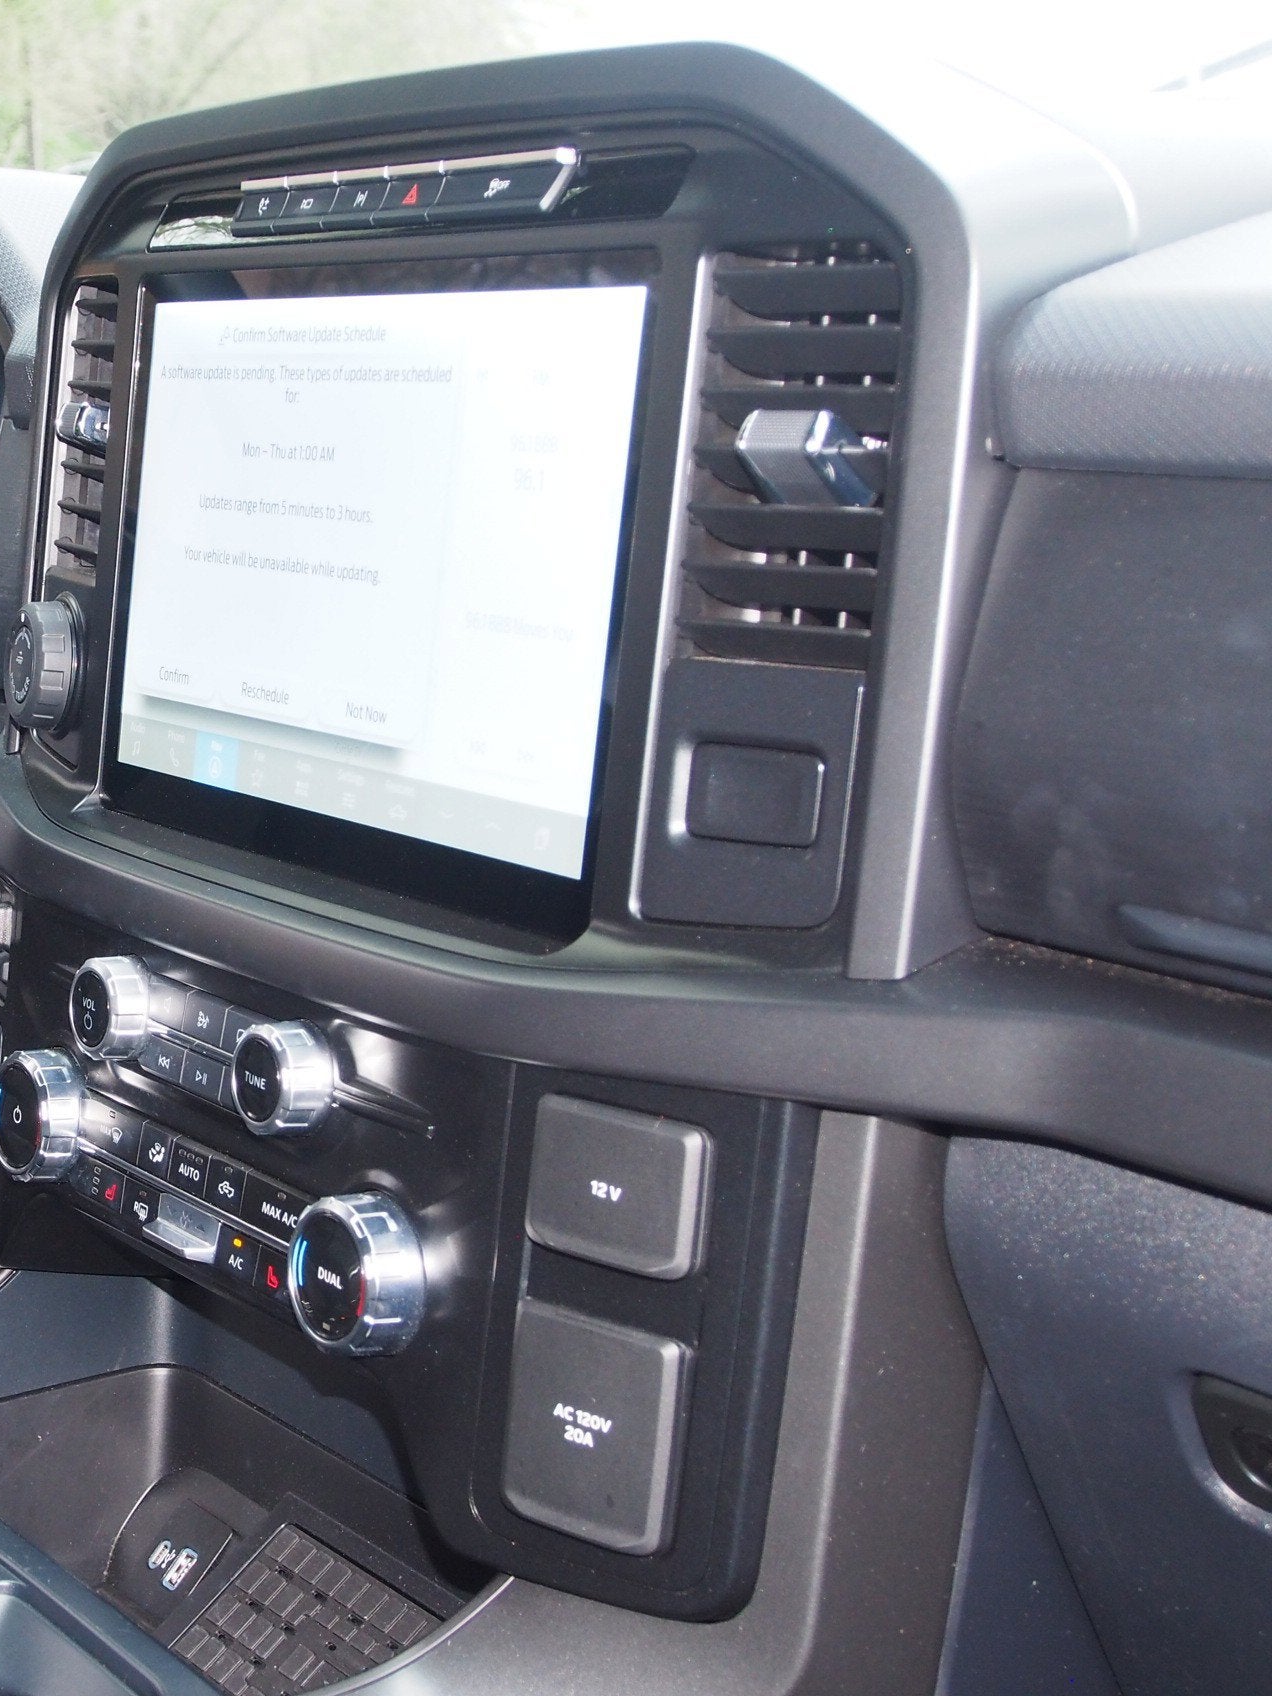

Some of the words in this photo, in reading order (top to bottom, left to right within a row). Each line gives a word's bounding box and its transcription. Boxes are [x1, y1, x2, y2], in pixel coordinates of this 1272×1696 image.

[233, 326, 265, 344] Confirm
[268, 326, 306, 342] Software
[309, 327, 341, 343] Update
[343, 325, 386, 342] Schedule
[161, 367, 167, 379] A
[168, 365, 202, 380] software
[203, 366, 232, 381] update
[233, 366, 240, 380] is
[241, 365, 277, 382] pending.
[280, 365, 304, 380] These
[307, 366, 331, 383] types
[333, 365, 343, 381] of
[344, 365, 382, 383] updates
[384, 368, 399, 382] are
[401, 365, 453, 383] scheduled
[285, 387, 300, 405] for:
[242, 443, 260, 458] Mon
[270, 444, 286, 460] Thu
[287, 446, 297, 460] at
[299, 445, 318, 462] 1:00
[320, 446, 335, 462] AM
[199, 494, 233, 511] Updates
[234, 499, 258, 515] range
[259, 498, 280, 514] from
[280, 500, 287, 516] 5
[288, 502, 324, 519] minutes
[326, 506, 335, 520] to
[337, 505, 343, 521] 3
[344, 505, 374, 524] hours.
[184, 546, 202, 561] Your
[202, 550, 230, 565] vehicle
[232, 552, 246, 567] will
[248, 553, 258, 569] be
[259, 555, 309, 575] unavailable
[311, 560, 335, 578] while
[337, 564, 381, 586] updating.
[159, 666, 190, 685] Confirm
[241, 682, 289, 705] Reschedule
[345, 701, 363, 721] Not
[365, 705, 387, 724] Now
[82, 997, 96, 1012] VOL
[244, 1070, 266, 1090] TUNE
[178, 1163, 200, 1182] AUTO
[590, 1180, 608, 1199] 12
[609, 1184, 623, 1203] V
[261, 1201, 282, 1221] MAX
[281, 1211, 298, 1229] A/C
[229, 1254, 244, 1271] A/C
[317, 1266, 342, 1290] DUAL
[553, 1402, 574, 1423] AC
[575, 1409, 612, 1435] 120V
[564, 1425, 594, 1449] 20A
